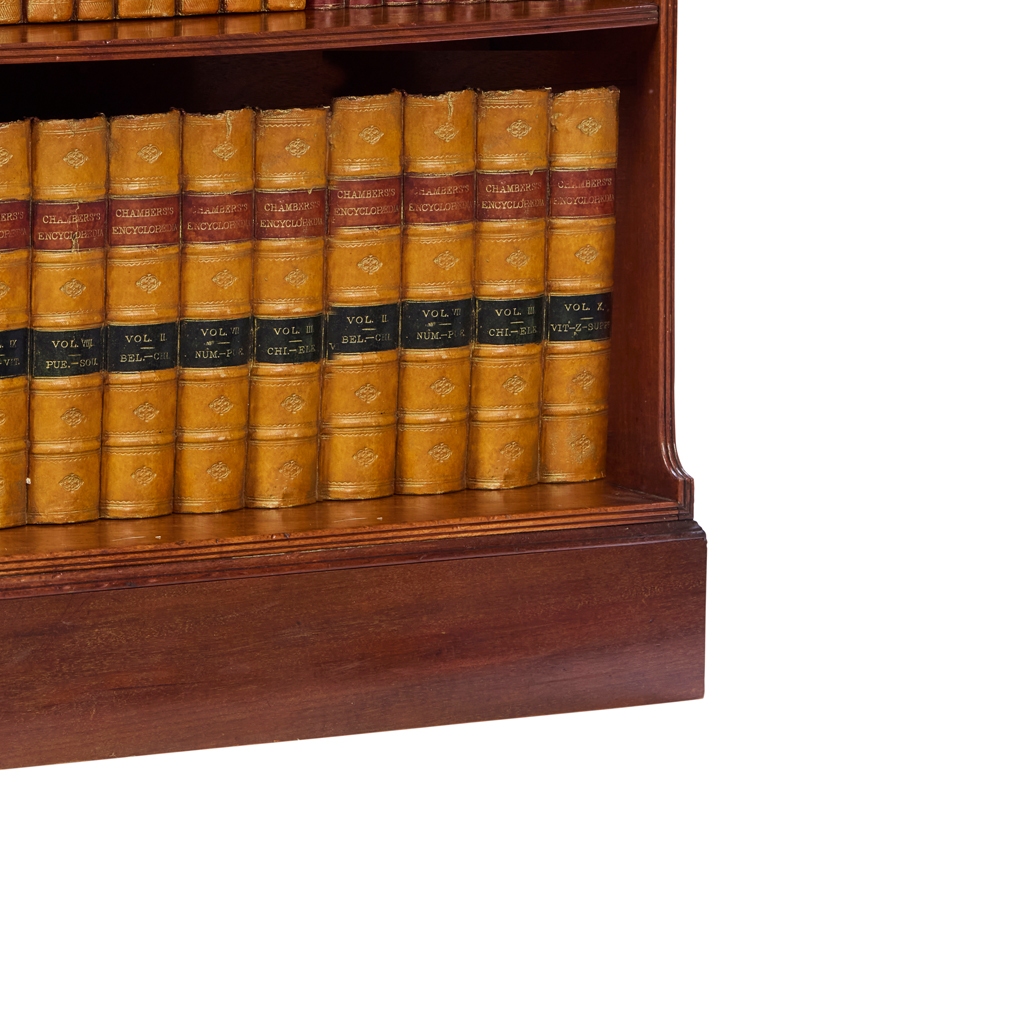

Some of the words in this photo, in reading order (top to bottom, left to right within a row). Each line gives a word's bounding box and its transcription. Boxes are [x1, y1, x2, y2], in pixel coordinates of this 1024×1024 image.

[485, 182, 542, 193] CHAMBERS'S
[337, 188, 396, 199] CHAMBERS'S
[264, 201, 321, 212] CHAMBERS'S
[115, 207, 174, 218] CHAMBERS'S
[494, 307, 521, 317] VOL.
[564, 302, 590, 312] VOL.
[422, 309, 449, 318] VOL.
[347, 315, 374, 325] VOL.
[201, 328, 228, 337] VOL.
[273, 326, 300, 336] VOL.
[51, 338, 79, 348] VOL.
[125, 333, 152, 343] VOL.
